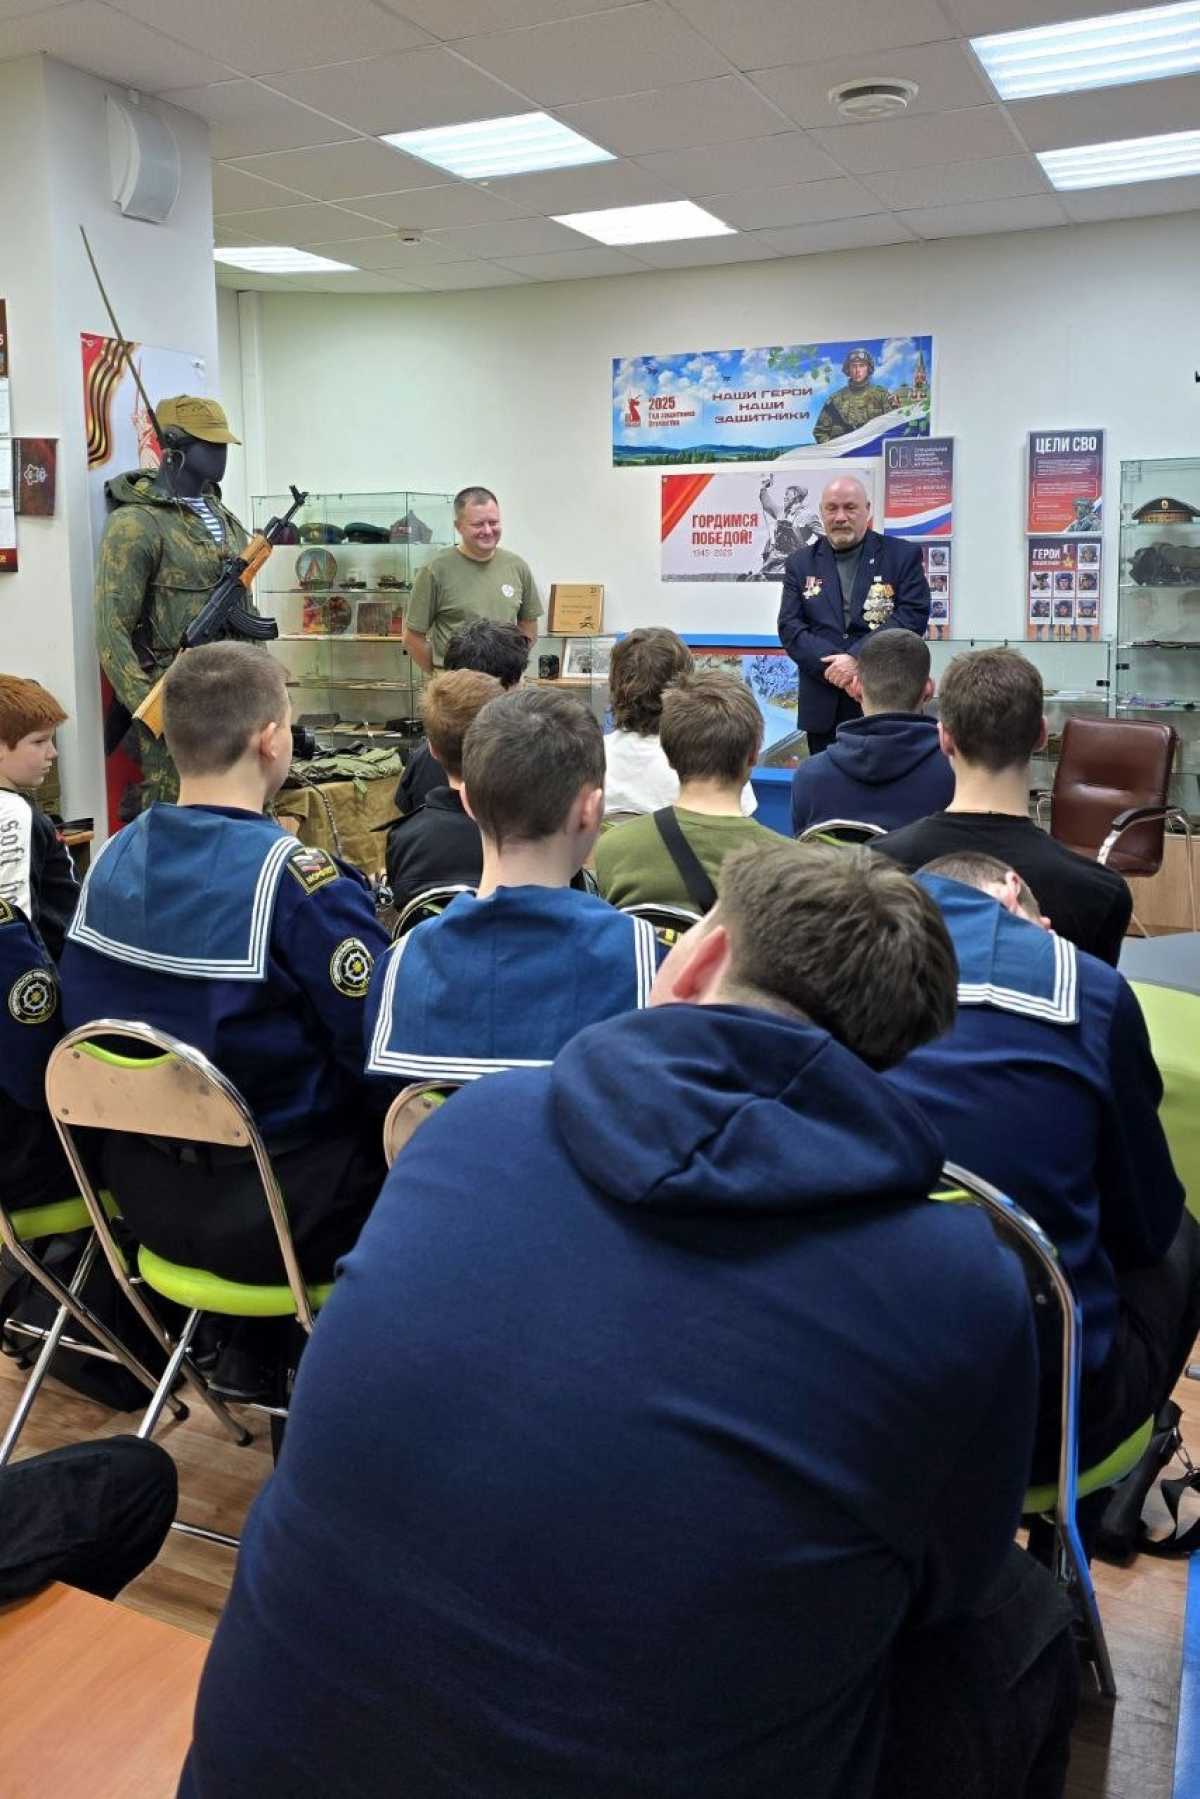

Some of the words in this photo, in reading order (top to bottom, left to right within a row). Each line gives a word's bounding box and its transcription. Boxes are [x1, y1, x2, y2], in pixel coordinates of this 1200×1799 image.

[712, 391, 757, 401] НАШИ
[761, 387, 813, 399] ГЕРОИ
[648, 395, 676, 410] 2025
[739, 401, 785, 411] НАШИ
[1035, 437, 1070, 454] ЦЕЛИ
[1072, 436, 1098, 452] СВО
[692, 513, 759, 530] ГОРДИМСЯ
[692, 529, 753, 547] ПОБЕДОЙ!
[1031, 548, 1061, 560] ГЕРОИ
